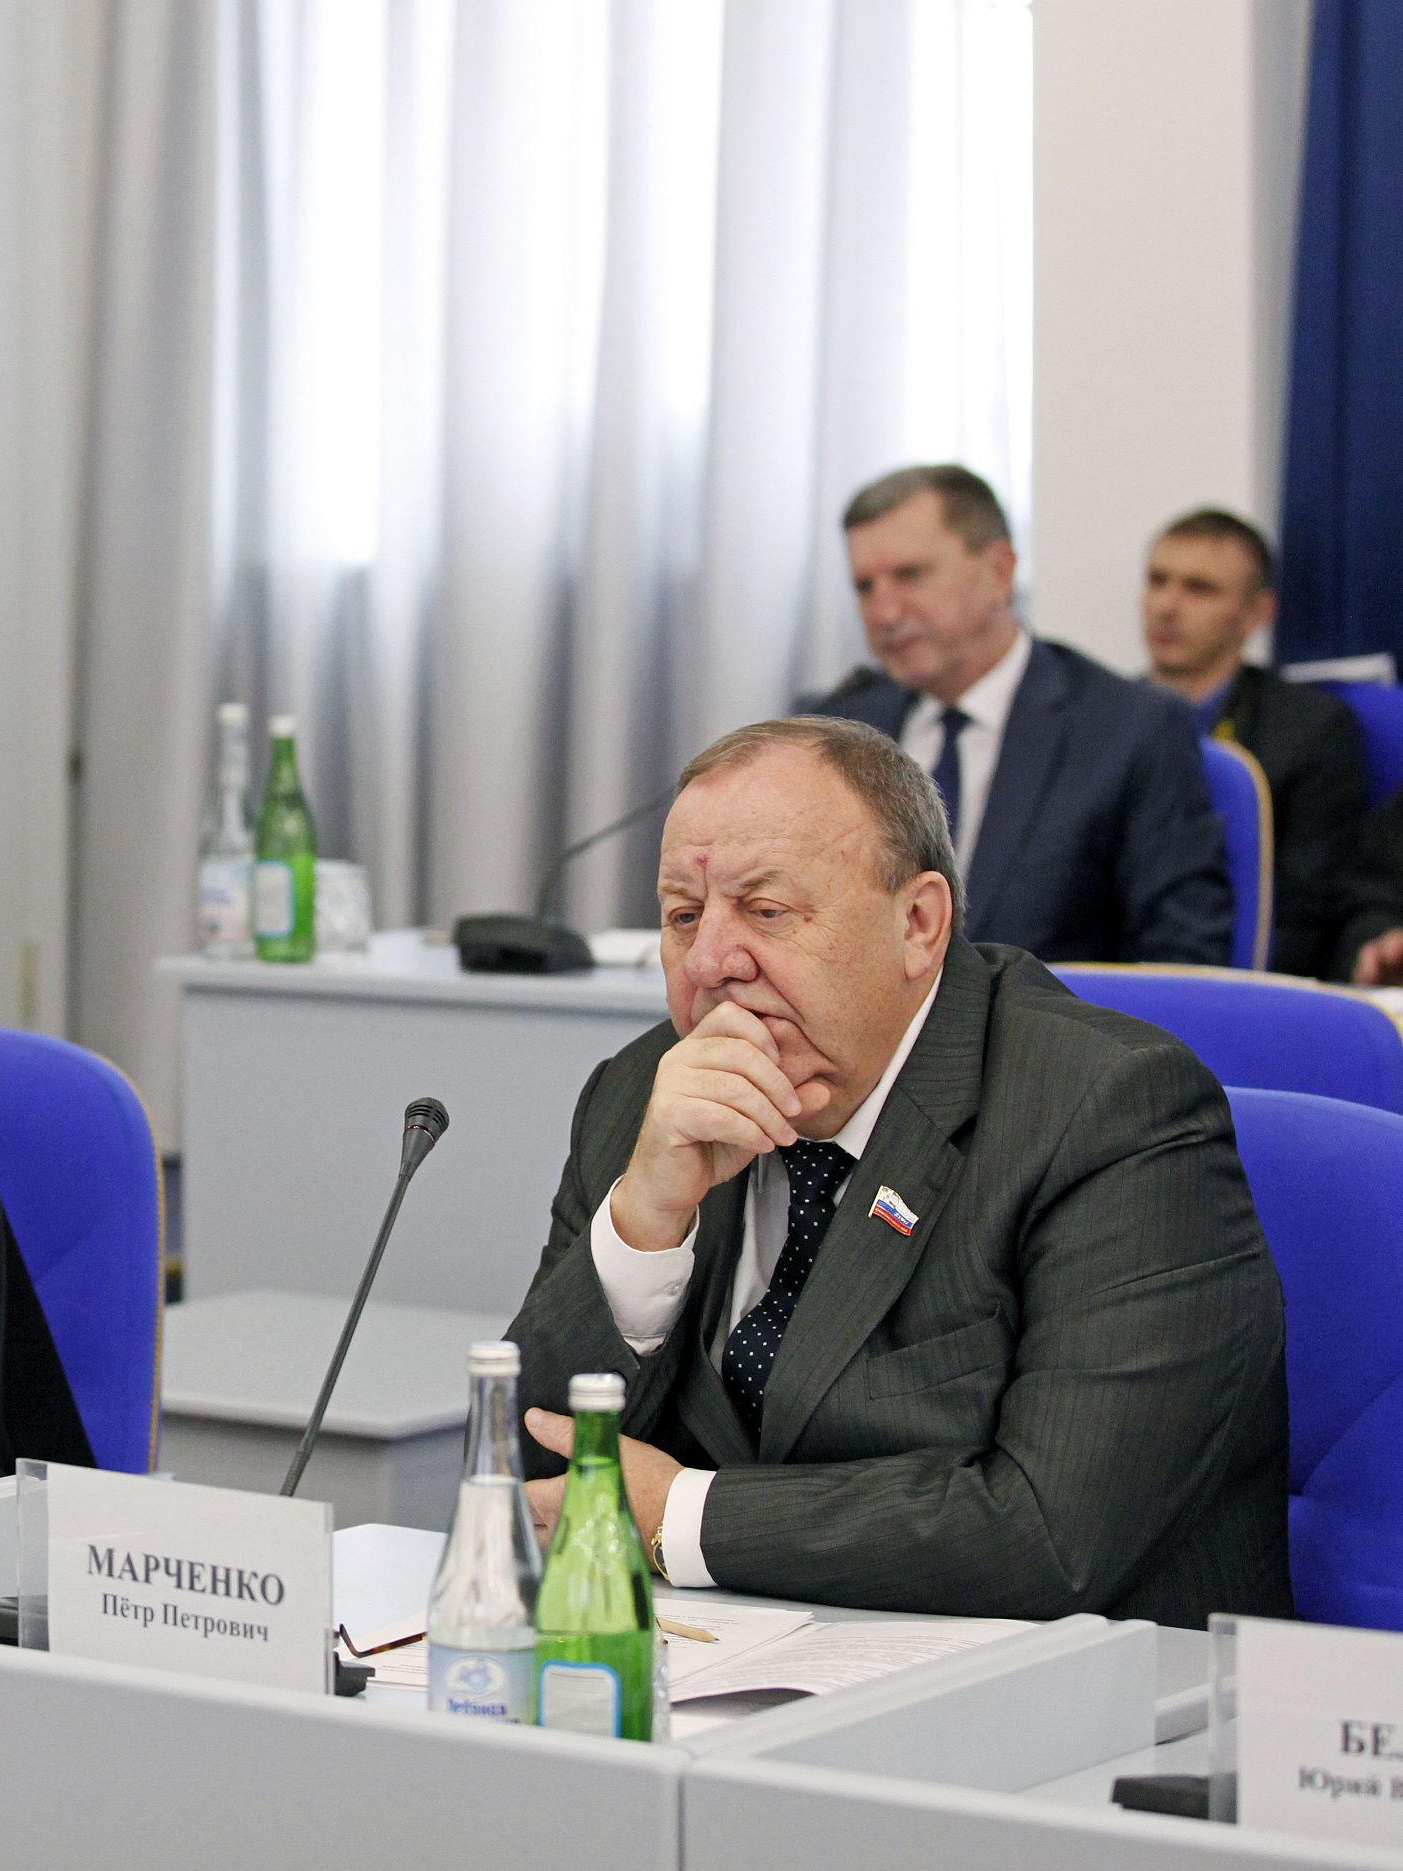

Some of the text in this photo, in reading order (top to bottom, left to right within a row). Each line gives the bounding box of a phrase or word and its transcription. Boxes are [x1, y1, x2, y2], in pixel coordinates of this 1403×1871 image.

[87, 1544, 286, 1606] МАРЧЕНКО
[101, 1593, 269, 1642] Пётр Петрович
[1340, 1719, 1403, 1761] БЕ
[1298, 1766, 1382, 1800] Юрий
